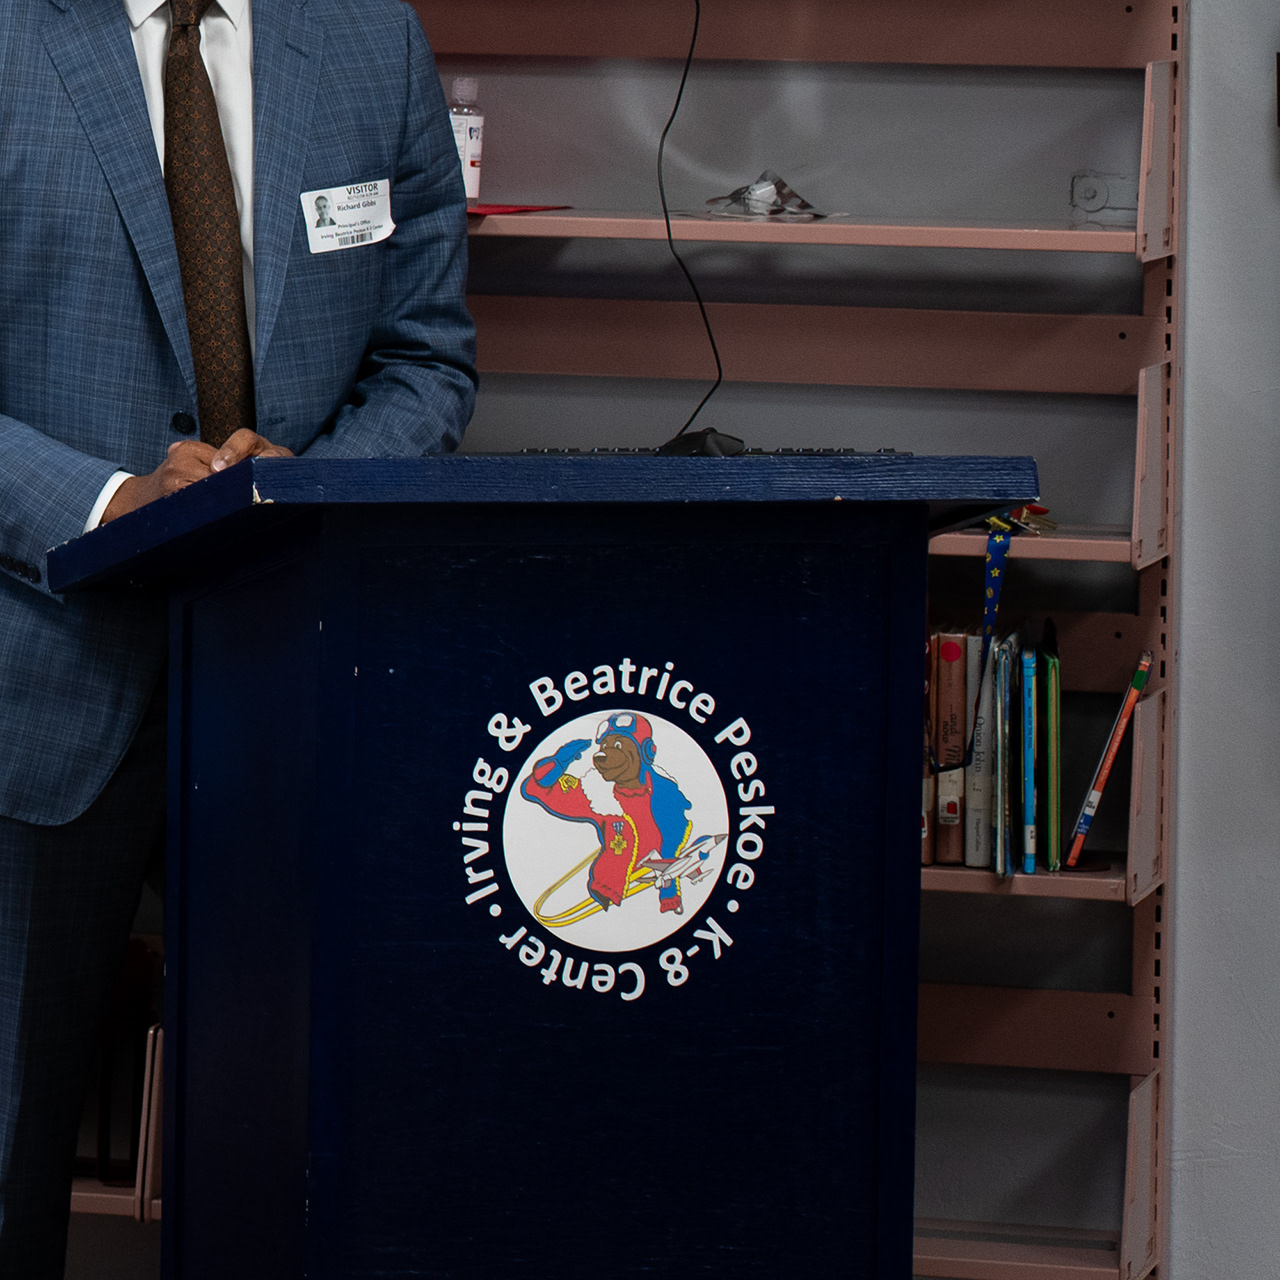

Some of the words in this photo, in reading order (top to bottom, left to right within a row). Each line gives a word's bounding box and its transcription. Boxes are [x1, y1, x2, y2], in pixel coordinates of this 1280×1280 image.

[337, 202, 361, 212] Richard
[361, 200, 377, 209] Gibbs
[346, 182, 379, 195] VISITOR
[528, 657, 717, 725] Beatrice
[487, 711, 532, 752] &
[973, 716, 985, 747] Onion
[973, 750, 985, 773] John
[713, 716, 776, 891] Peskoe
[452, 757, 510, 905] Irving
[498, 924, 646, 1002] Center
[658, 916, 735, 988] K-8
